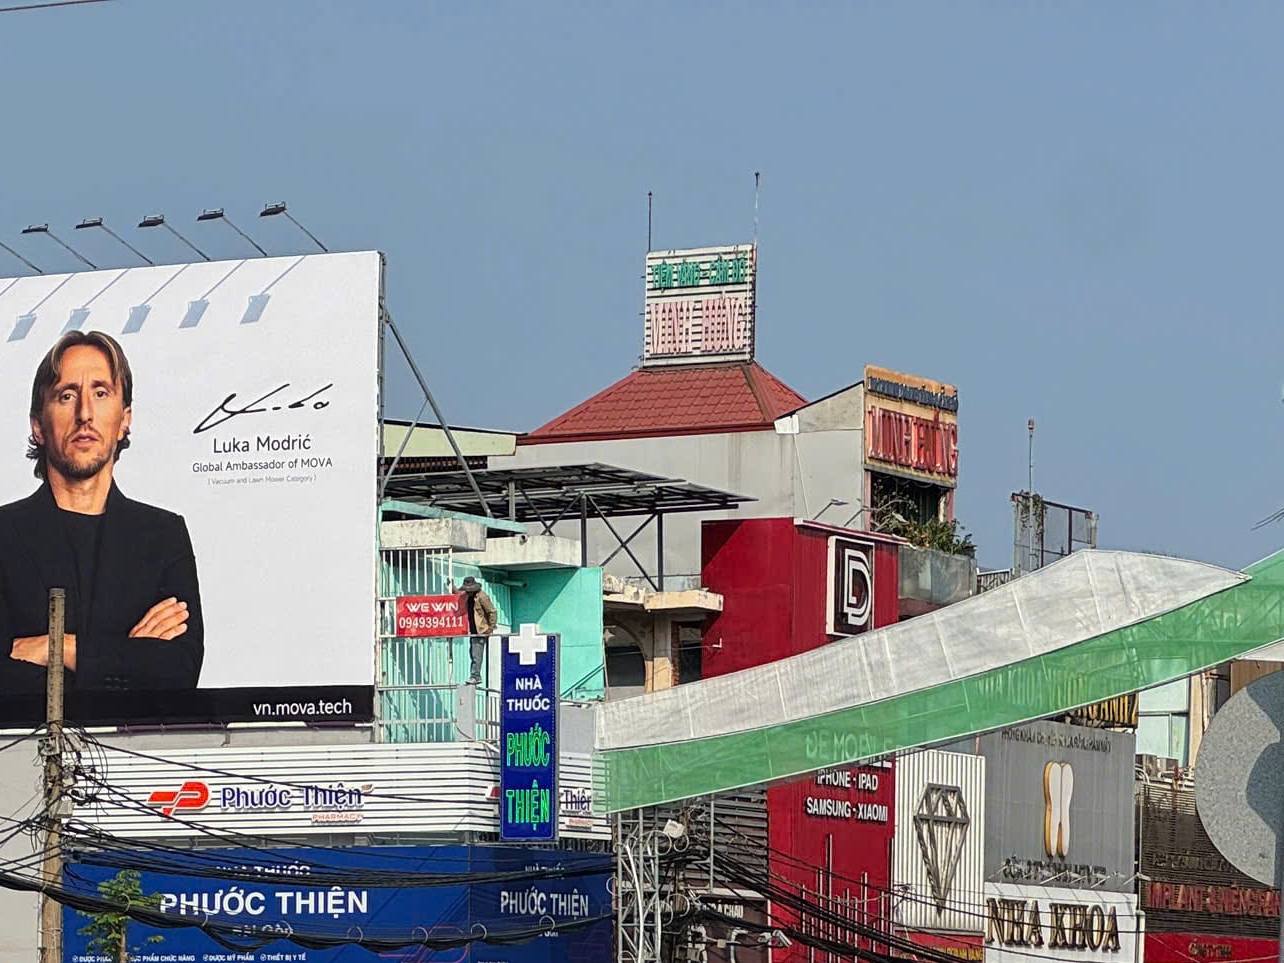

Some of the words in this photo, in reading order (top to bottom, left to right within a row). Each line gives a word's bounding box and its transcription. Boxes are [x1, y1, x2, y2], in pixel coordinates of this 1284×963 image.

[213, 437, 250, 454] Luka
[256, 434, 312, 452] Modrić
[192, 461, 223, 473] Global
[225, 459, 286, 472] Ambassador
[288, 459, 298, 469] of
[301, 457, 333, 468] MOVA
[406, 602, 430, 613] WE
[431, 600, 460, 612] WIN
[399, 615, 464, 630] 0949394111
[515, 674, 543, 691] NHÀ
[253, 698, 352, 716] vn.mova.tech
[506, 694, 551, 713] THUỐC
[506, 722, 551, 768] PHƯỚC
[858, 773, 878, 791] IPAD
[220, 785, 292, 810] Phước
[302, 782, 364, 811] Thiện
[506, 779, 550, 831] THIỆN
[311, 813, 364, 823] PHARMACY
[806, 796, 851, 818] SAMSUNG
[857, 803, 888, 822] XIAOMI
[160, 887, 266, 916] PHƯỚC
[275, 886, 368, 919] THIỆN
[500, 886, 547, 914] PHƯỚC
[550, 888, 589, 920] THIỆN
[986, 897, 1045, 947] NHA
[1048, 902, 1121, 953] KHOA
